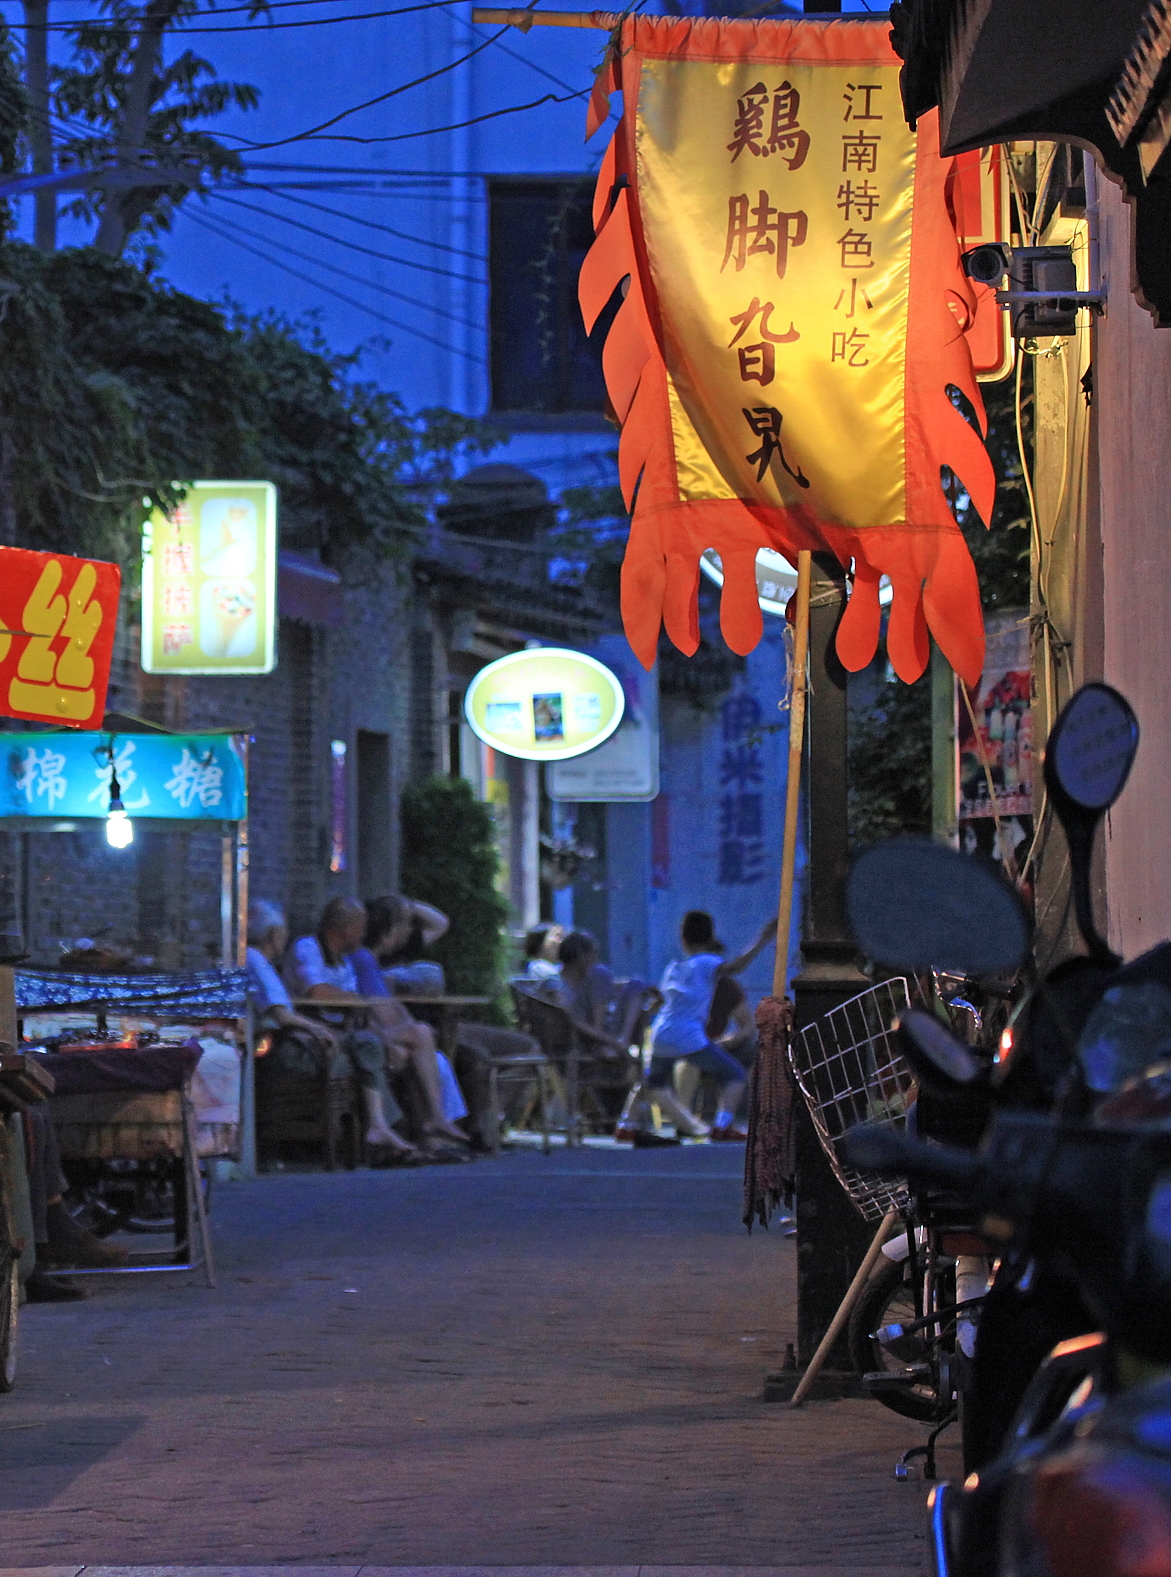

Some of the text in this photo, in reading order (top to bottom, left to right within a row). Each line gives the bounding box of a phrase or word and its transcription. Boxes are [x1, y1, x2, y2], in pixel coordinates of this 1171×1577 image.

[830, 82, 884, 369] 江南特色小吃
[16, 740, 224, 812] 棉花糖
